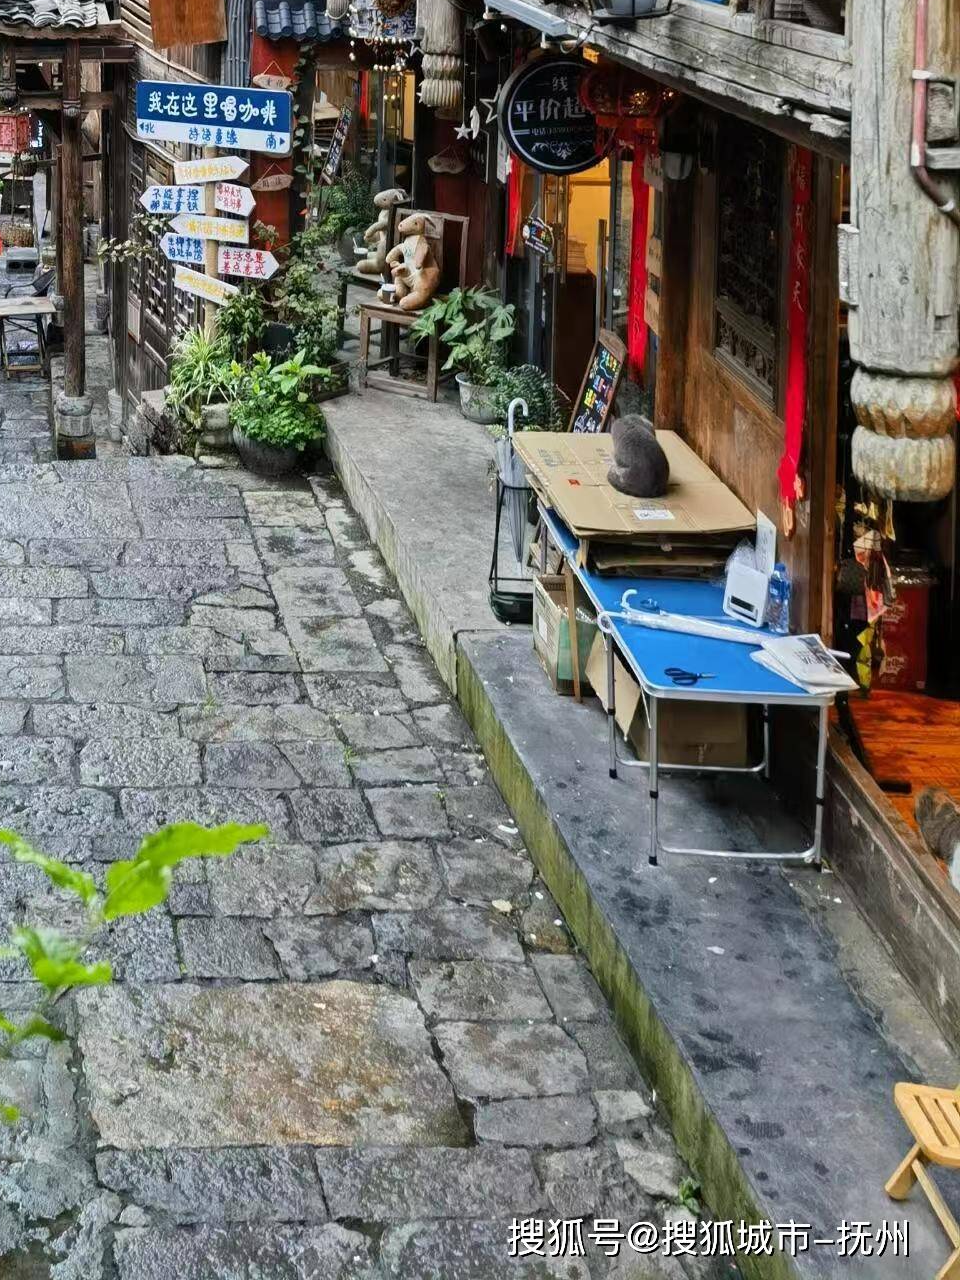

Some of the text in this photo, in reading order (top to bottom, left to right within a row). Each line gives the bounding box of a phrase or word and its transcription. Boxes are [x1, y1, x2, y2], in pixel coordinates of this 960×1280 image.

[148, 90, 277, 126] 我在这里喝咖啡
[265, 132, 277, 149] 南
